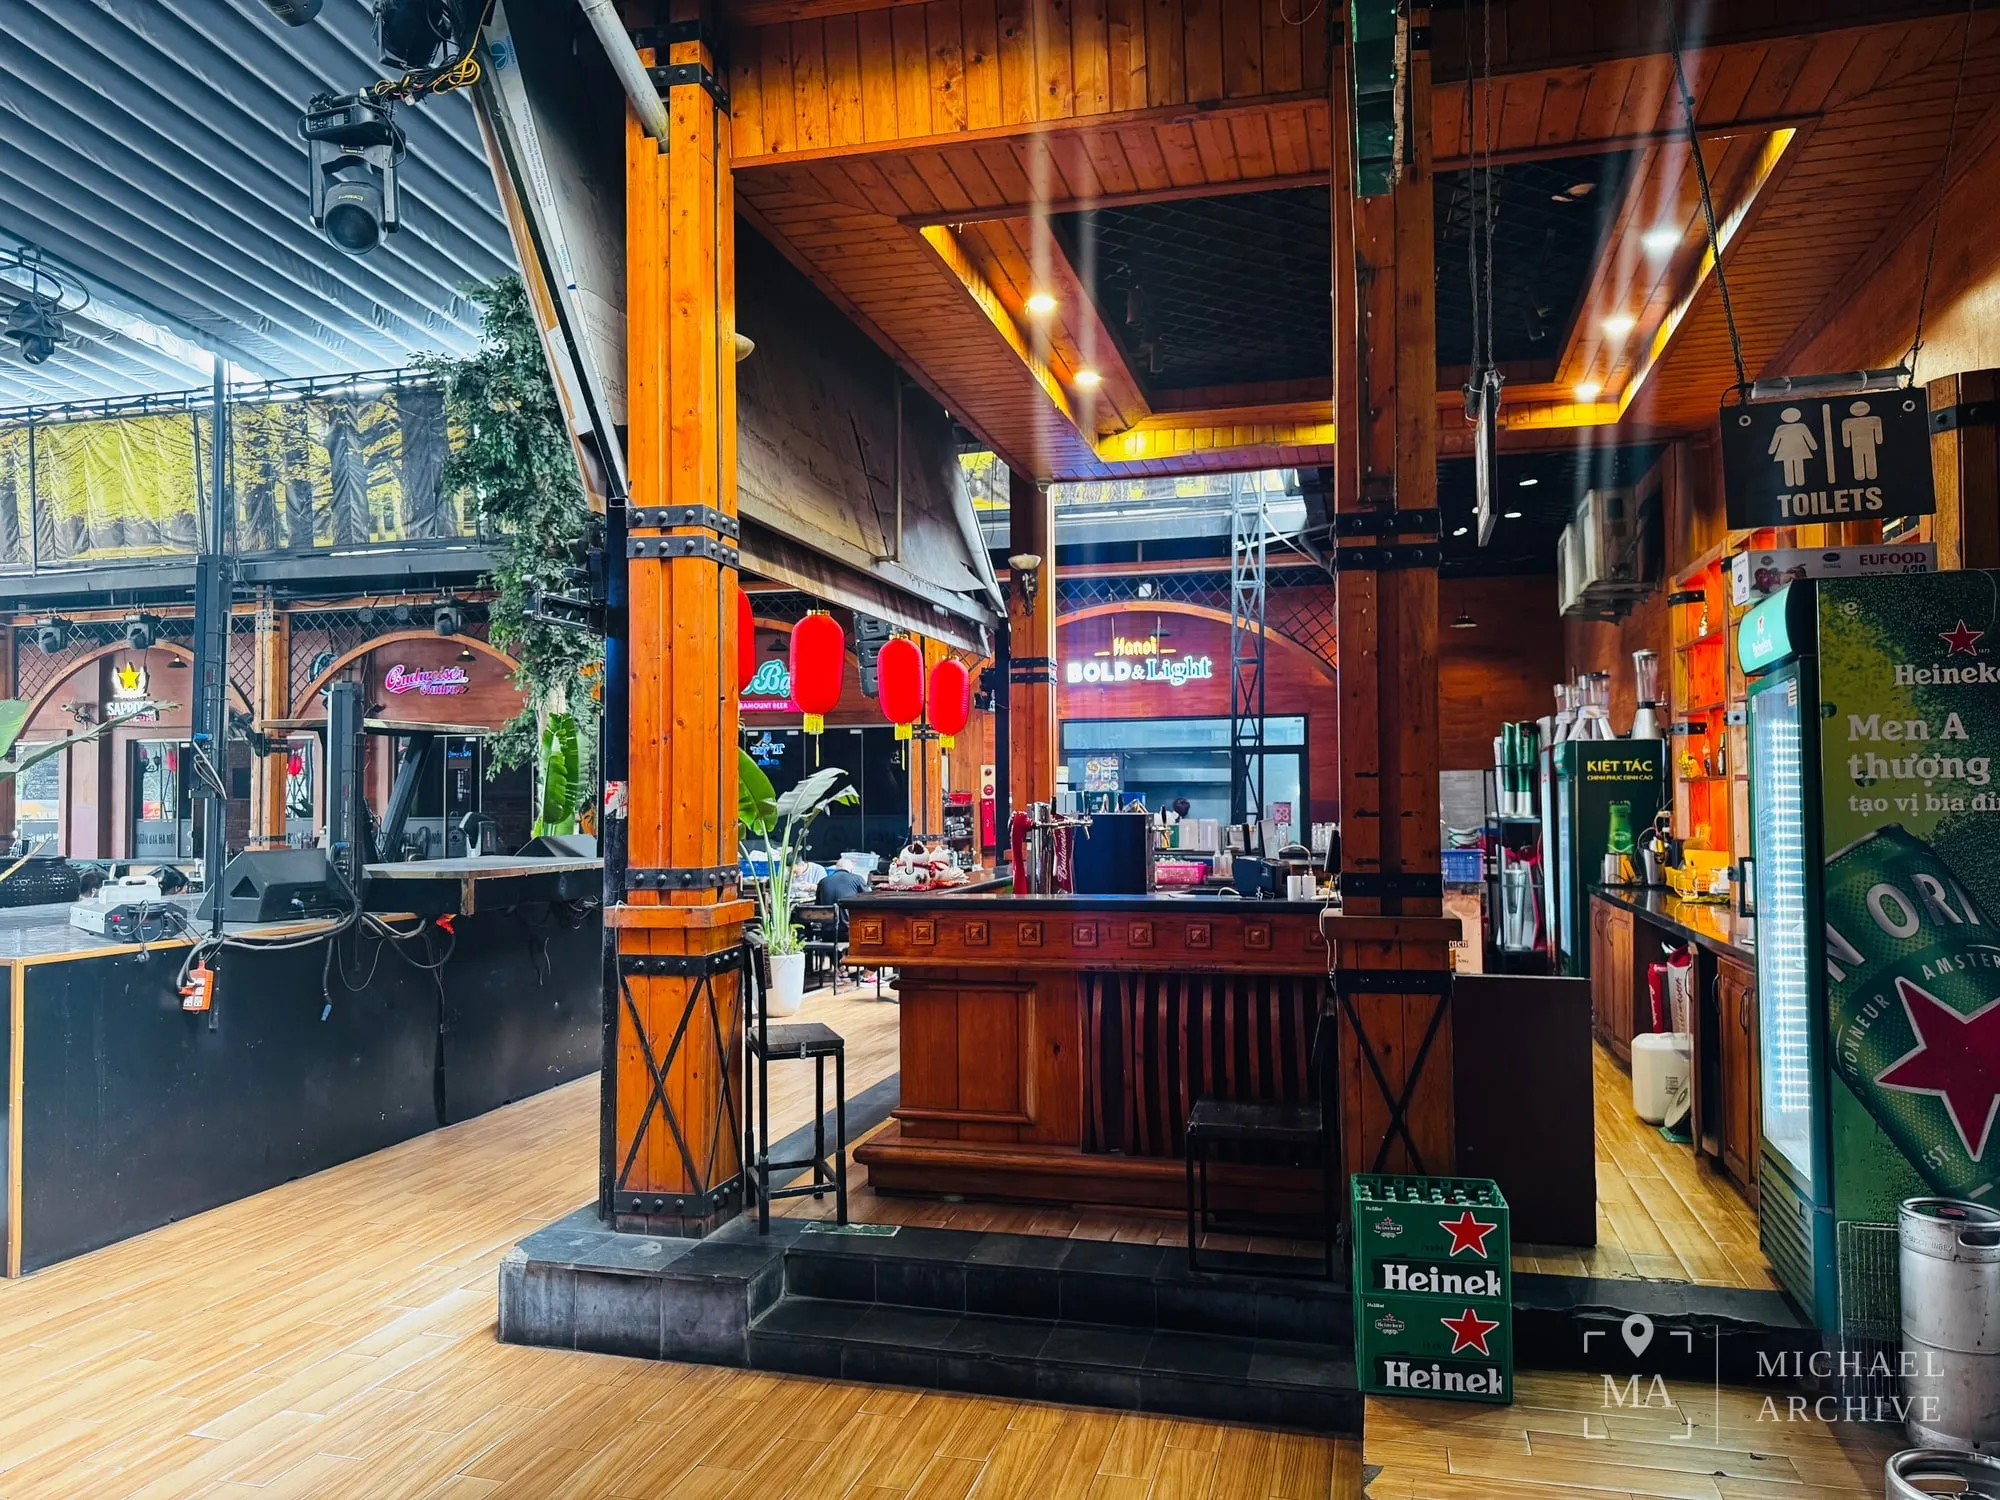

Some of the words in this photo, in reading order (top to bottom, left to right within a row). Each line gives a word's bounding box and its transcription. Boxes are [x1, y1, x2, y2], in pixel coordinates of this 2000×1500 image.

[1777, 487, 1883, 518] TOILETS
[1859, 552, 1926, 565] EUFOOD
[1112, 636, 1157, 656] Hanoi
[1894, 662, 2000, 685] Heinek
[1848, 714, 1929, 741] Men
[1940, 712, 1969, 739] A
[1587, 758, 1620, 773] KIỆT
[1623, 758, 1653, 771] TÁC
[1848, 752, 1990, 785] thượng
[1849, 795, 1888, 817] tạo
[1895, 793, 1919, 817] vị
[1925, 792, 1965, 811] bia
[1971, 791, 2000, 811] đỉ
[1056, 828, 1067, 882] Budweise
